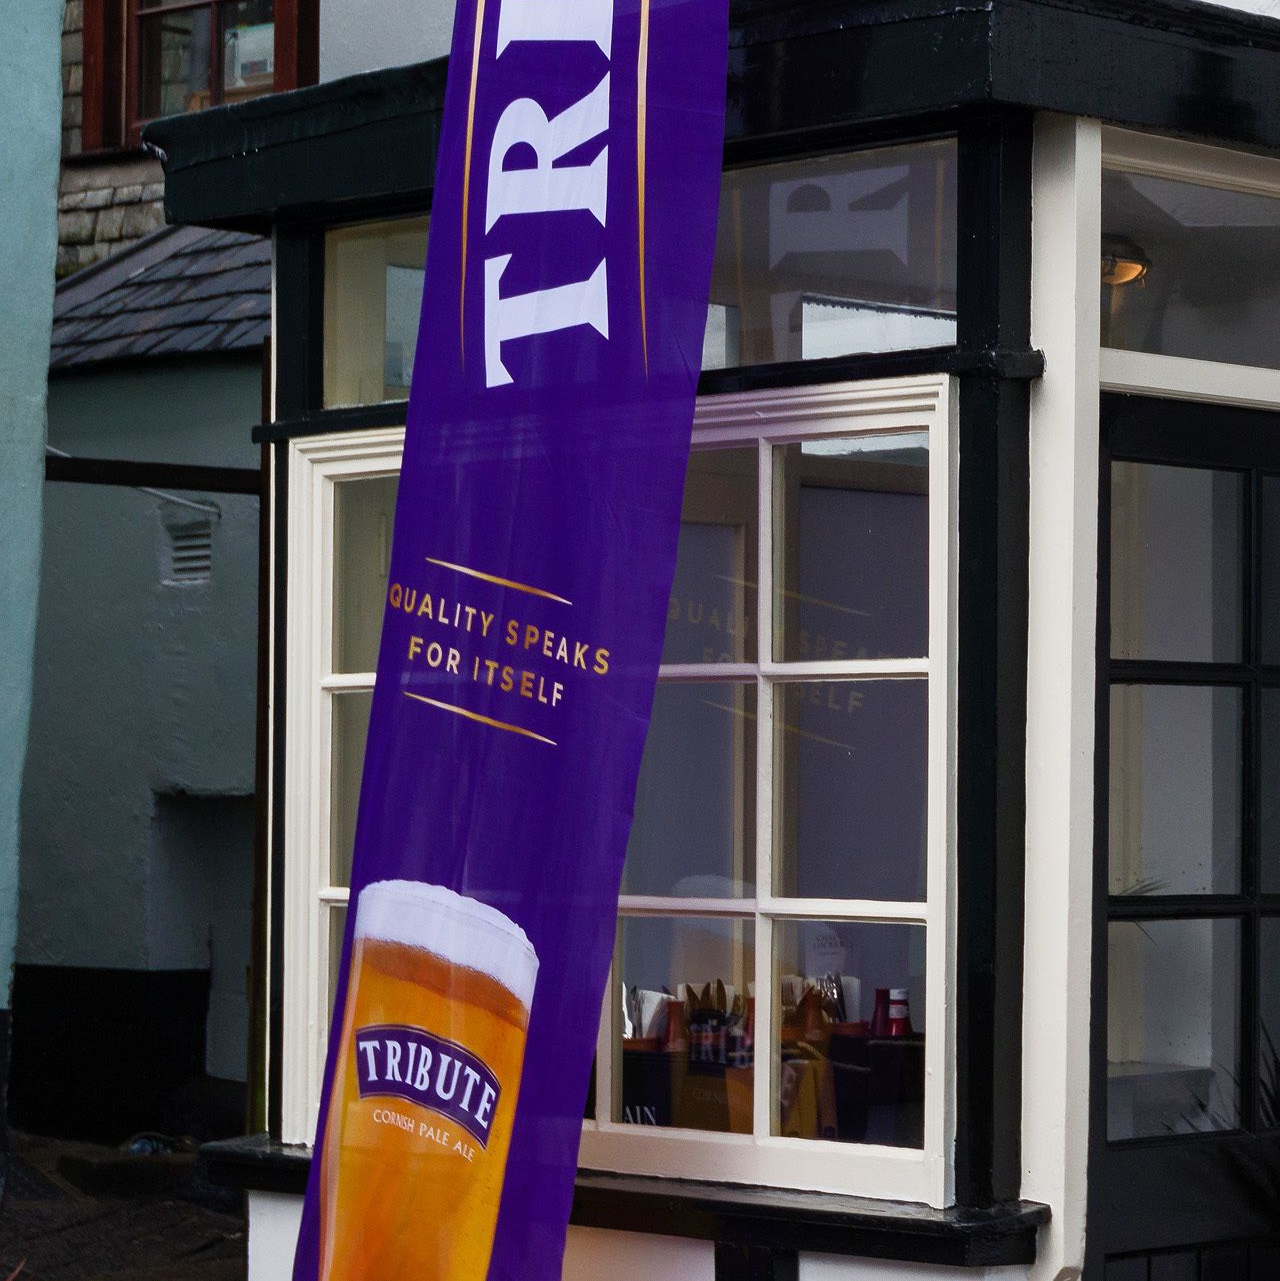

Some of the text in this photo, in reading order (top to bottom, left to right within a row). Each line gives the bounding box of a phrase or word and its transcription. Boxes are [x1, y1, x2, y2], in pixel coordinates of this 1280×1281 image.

[389, 583, 611, 675] QUALITY SPEAKS
[407, 635, 564, 708] FOR ITSELF
[359, 1039, 497, 1130] TRIBUTE
[372, 1108, 476, 1164] CORNISH PALE ALE
